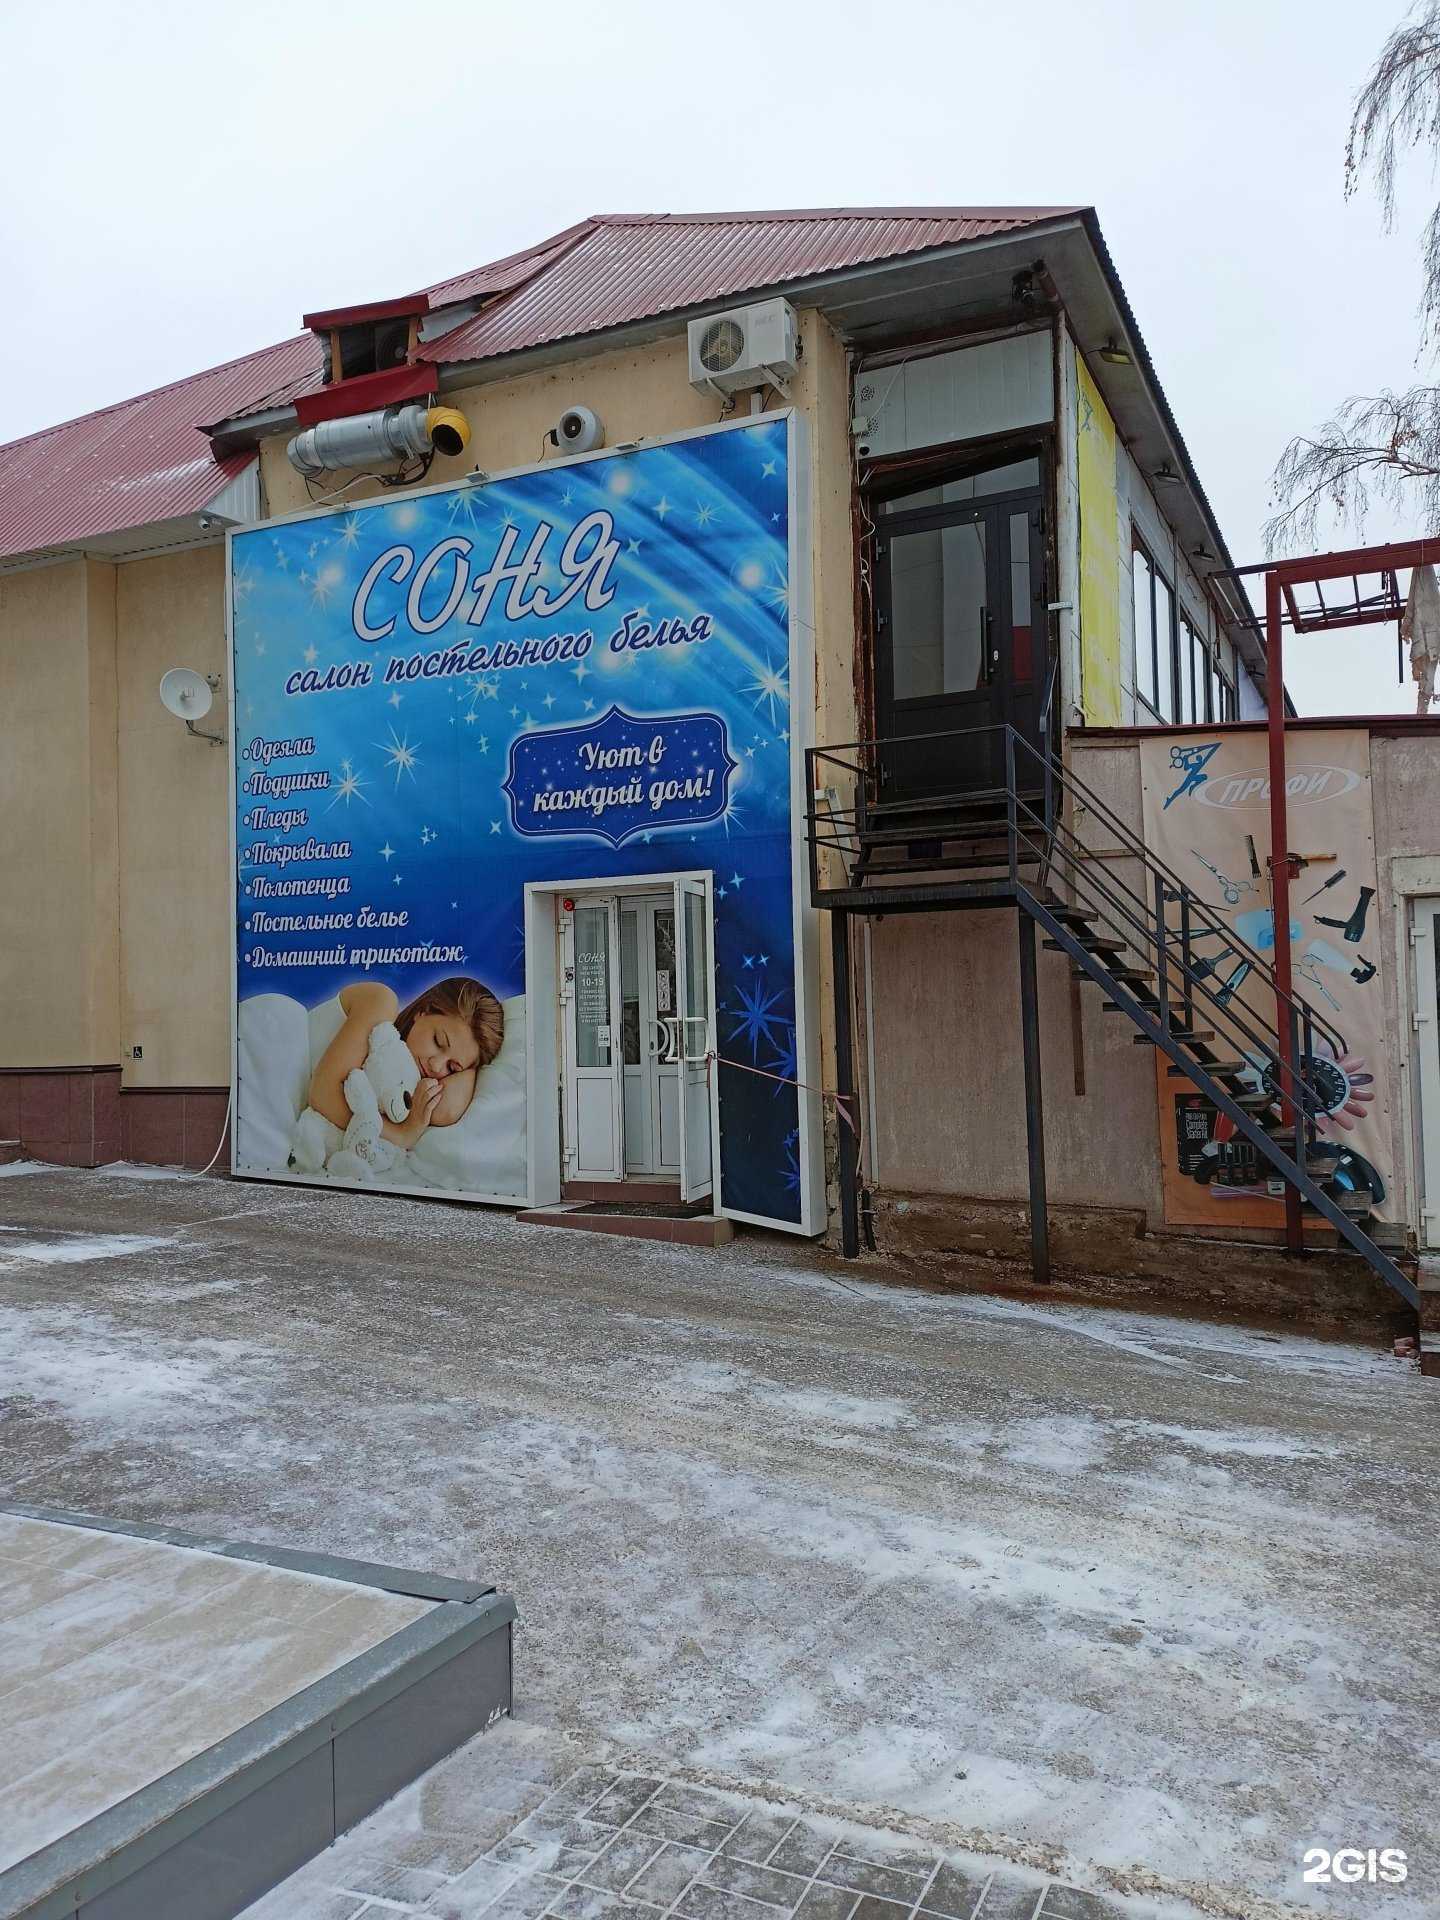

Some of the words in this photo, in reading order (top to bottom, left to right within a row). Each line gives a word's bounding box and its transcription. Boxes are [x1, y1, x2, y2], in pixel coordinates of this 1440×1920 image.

[352, 509, 622, 642] СОНЯ
[285, 664, 372, 695] салон
[385, 631, 592, 682] постельного
[609, 612, 713, 653] белья
[251, 737, 315, 765] Одеяла
[578, 743, 645, 771] Уют
[648, 735, 668, 764] в
[250, 770, 330, 799] Подушки
[533, 776, 645, 816] каждый
[648, 769, 714, 810] дом!
[251, 807, 308, 832] Пледы
[252, 838, 351, 868] Покрывала
[252, 875, 351, 899] Полотенца
[252, 912, 353, 933] Постельное
[356, 905, 409, 928] белье
[252, 944, 347, 968] Домашний
[349, 945, 465, 970] трикотаж
